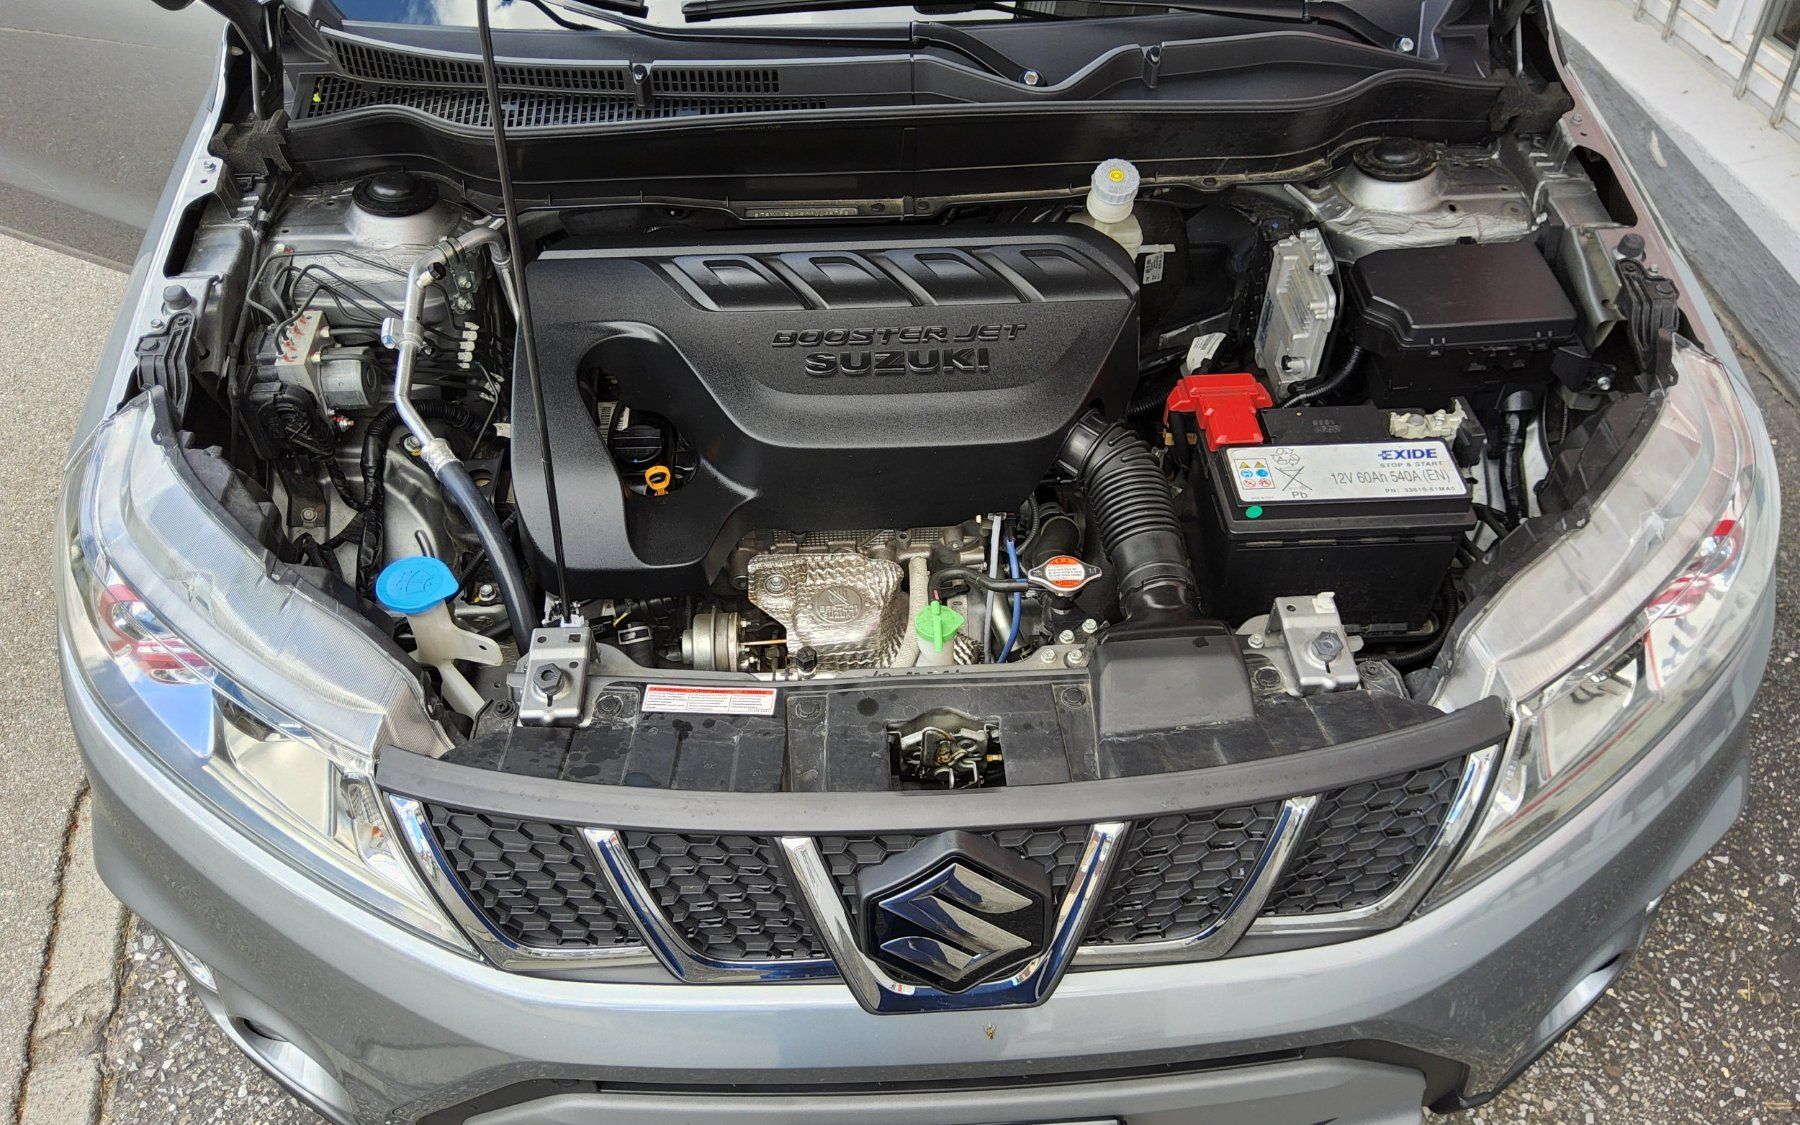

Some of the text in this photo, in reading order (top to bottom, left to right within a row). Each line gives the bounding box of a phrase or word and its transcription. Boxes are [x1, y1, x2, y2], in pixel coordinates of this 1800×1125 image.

[771, 323, 1027, 347] BOOSTER JET
[805, 348, 990, 376] SUZUKI
[1378, 448, 1437, 460] EXIDE
[1331, 469, 1450, 485] 12V 60Ah 540A (EN)
